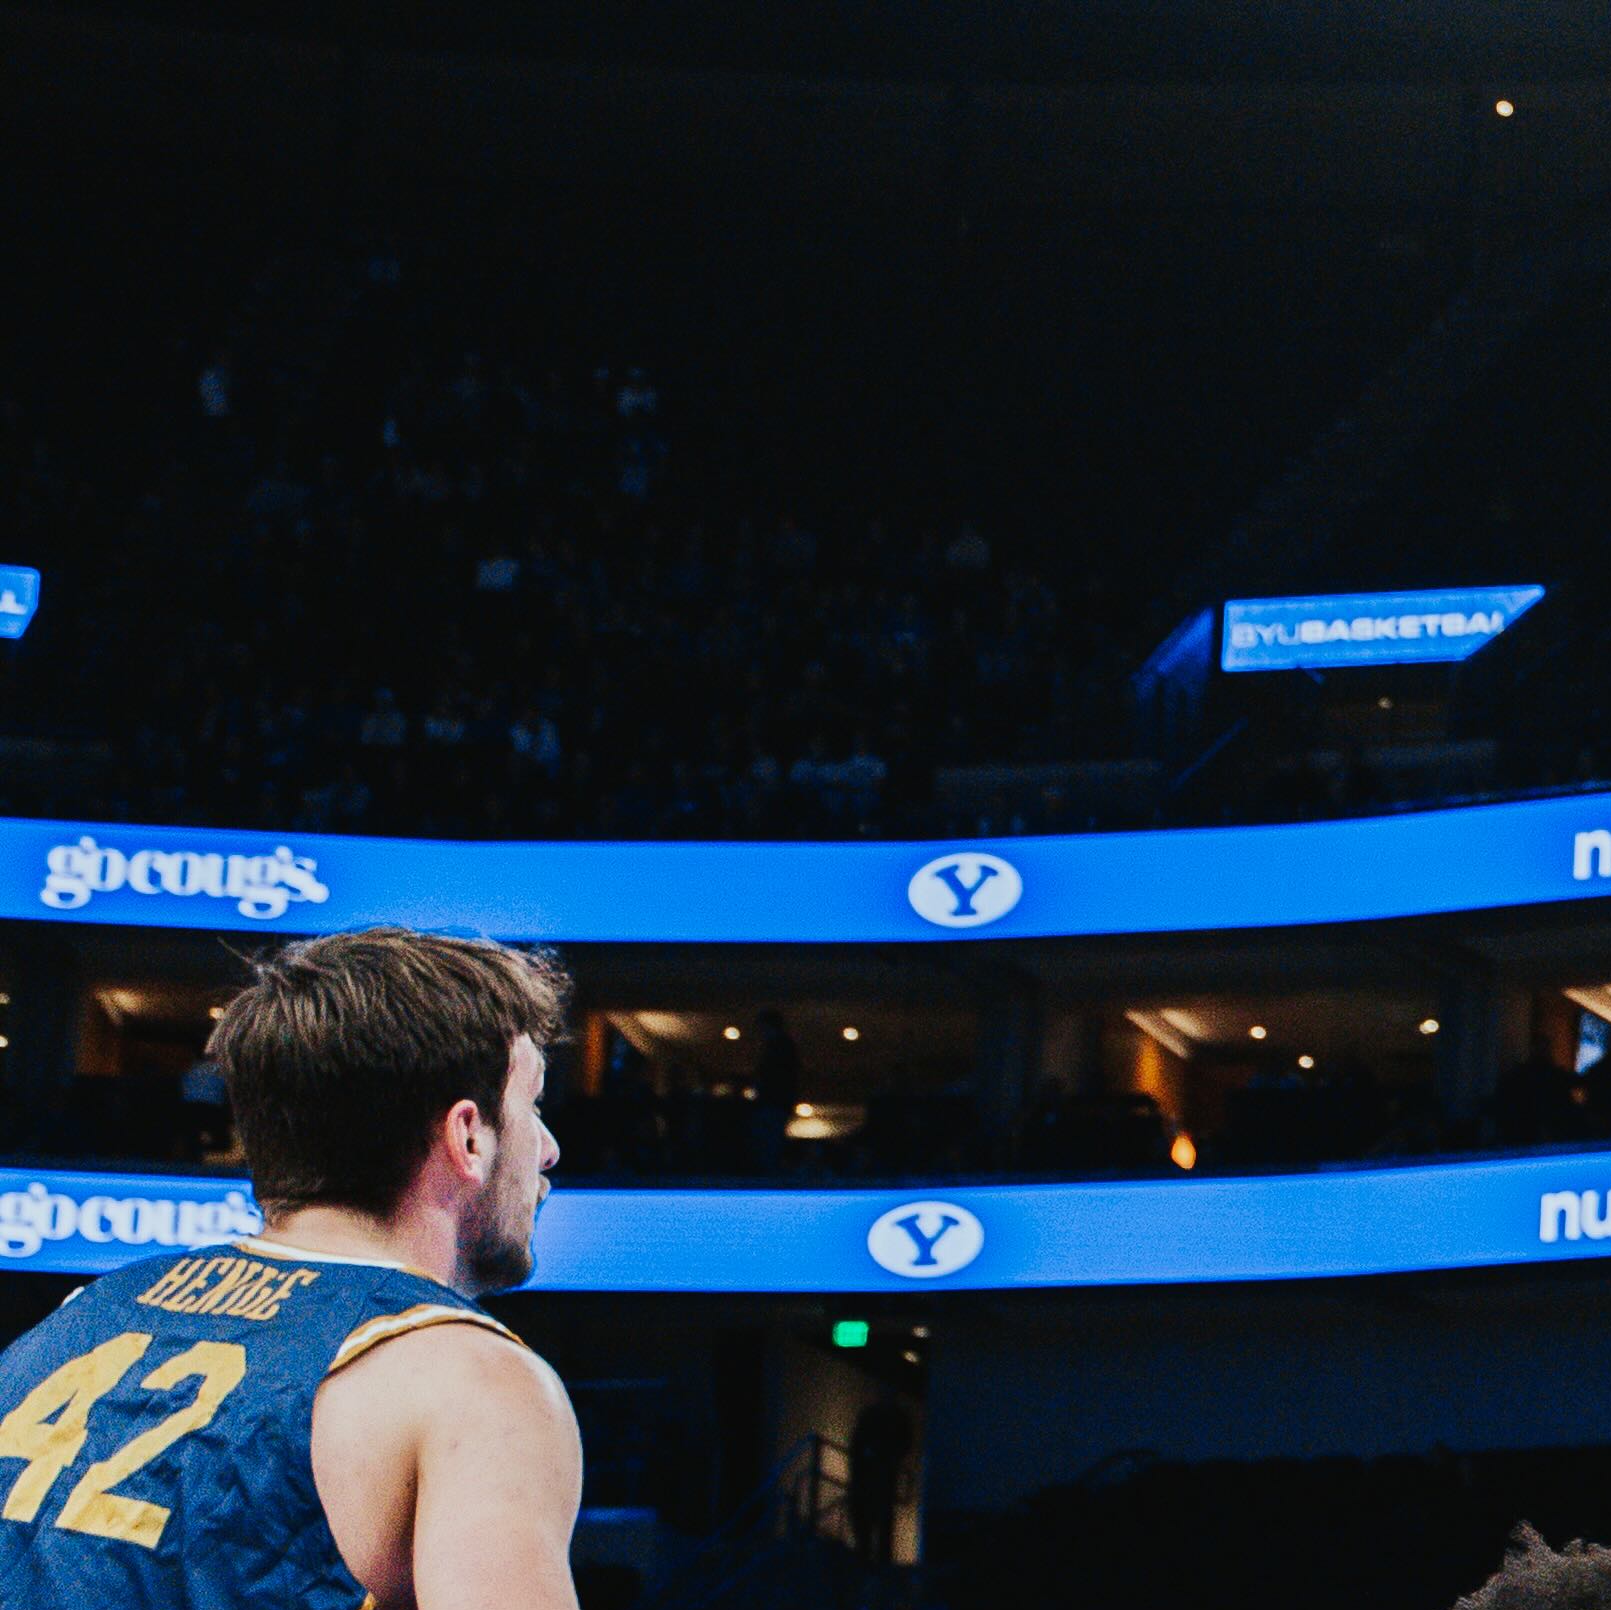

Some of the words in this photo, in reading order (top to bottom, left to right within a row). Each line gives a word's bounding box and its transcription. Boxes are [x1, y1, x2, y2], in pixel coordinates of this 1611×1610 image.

[933, 863, 1000, 917] Y
[895, 1213, 958, 1266] Y
[0, 1332, 247, 1550] 42
